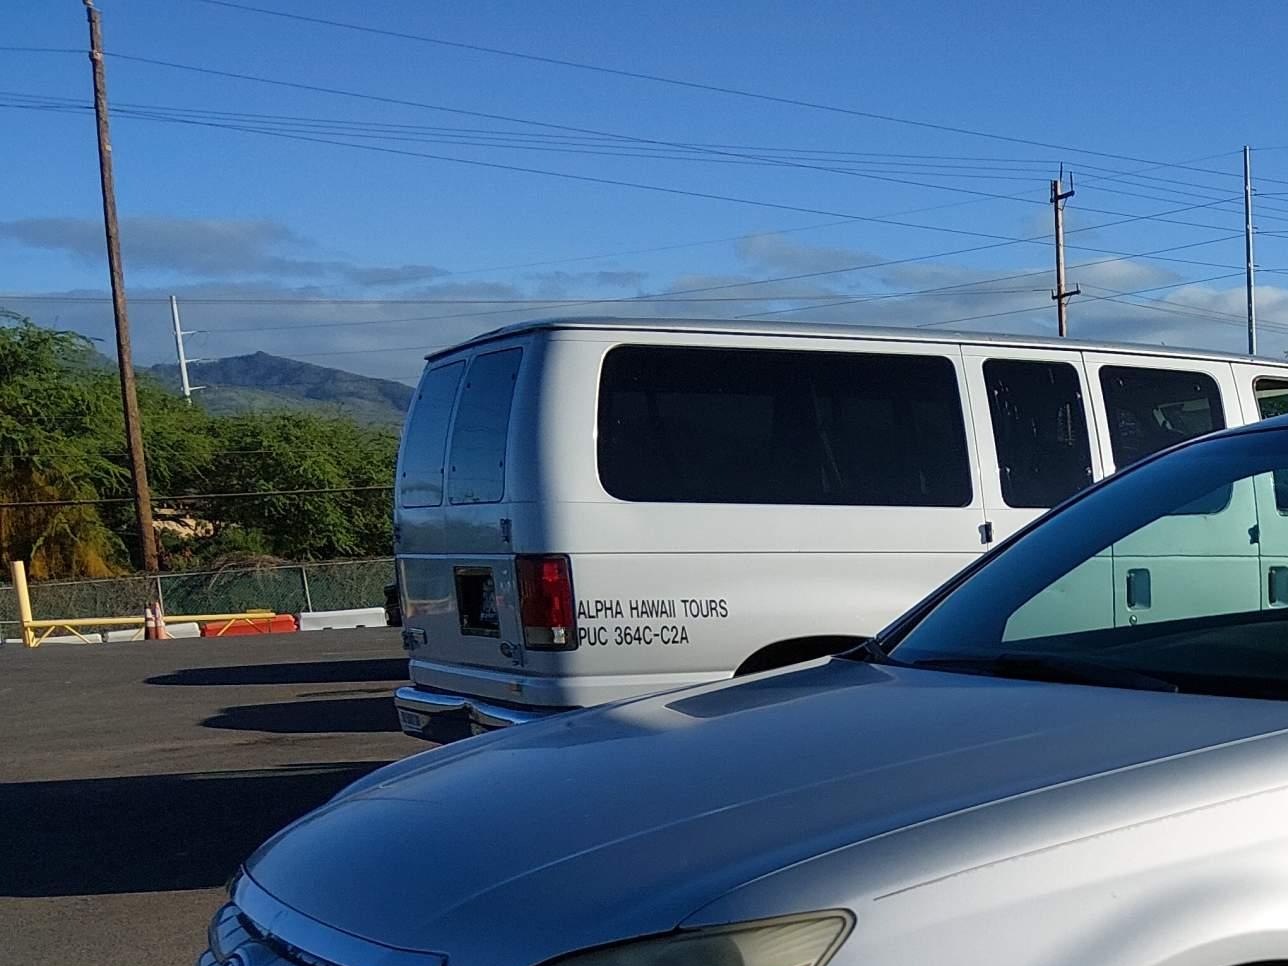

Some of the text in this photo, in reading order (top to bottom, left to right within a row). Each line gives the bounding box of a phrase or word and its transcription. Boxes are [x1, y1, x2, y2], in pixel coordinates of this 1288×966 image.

[577, 599, 729, 619] ALPHA HAWAII TOURS
[578, 625, 690, 648] PUC 364C-C2A
